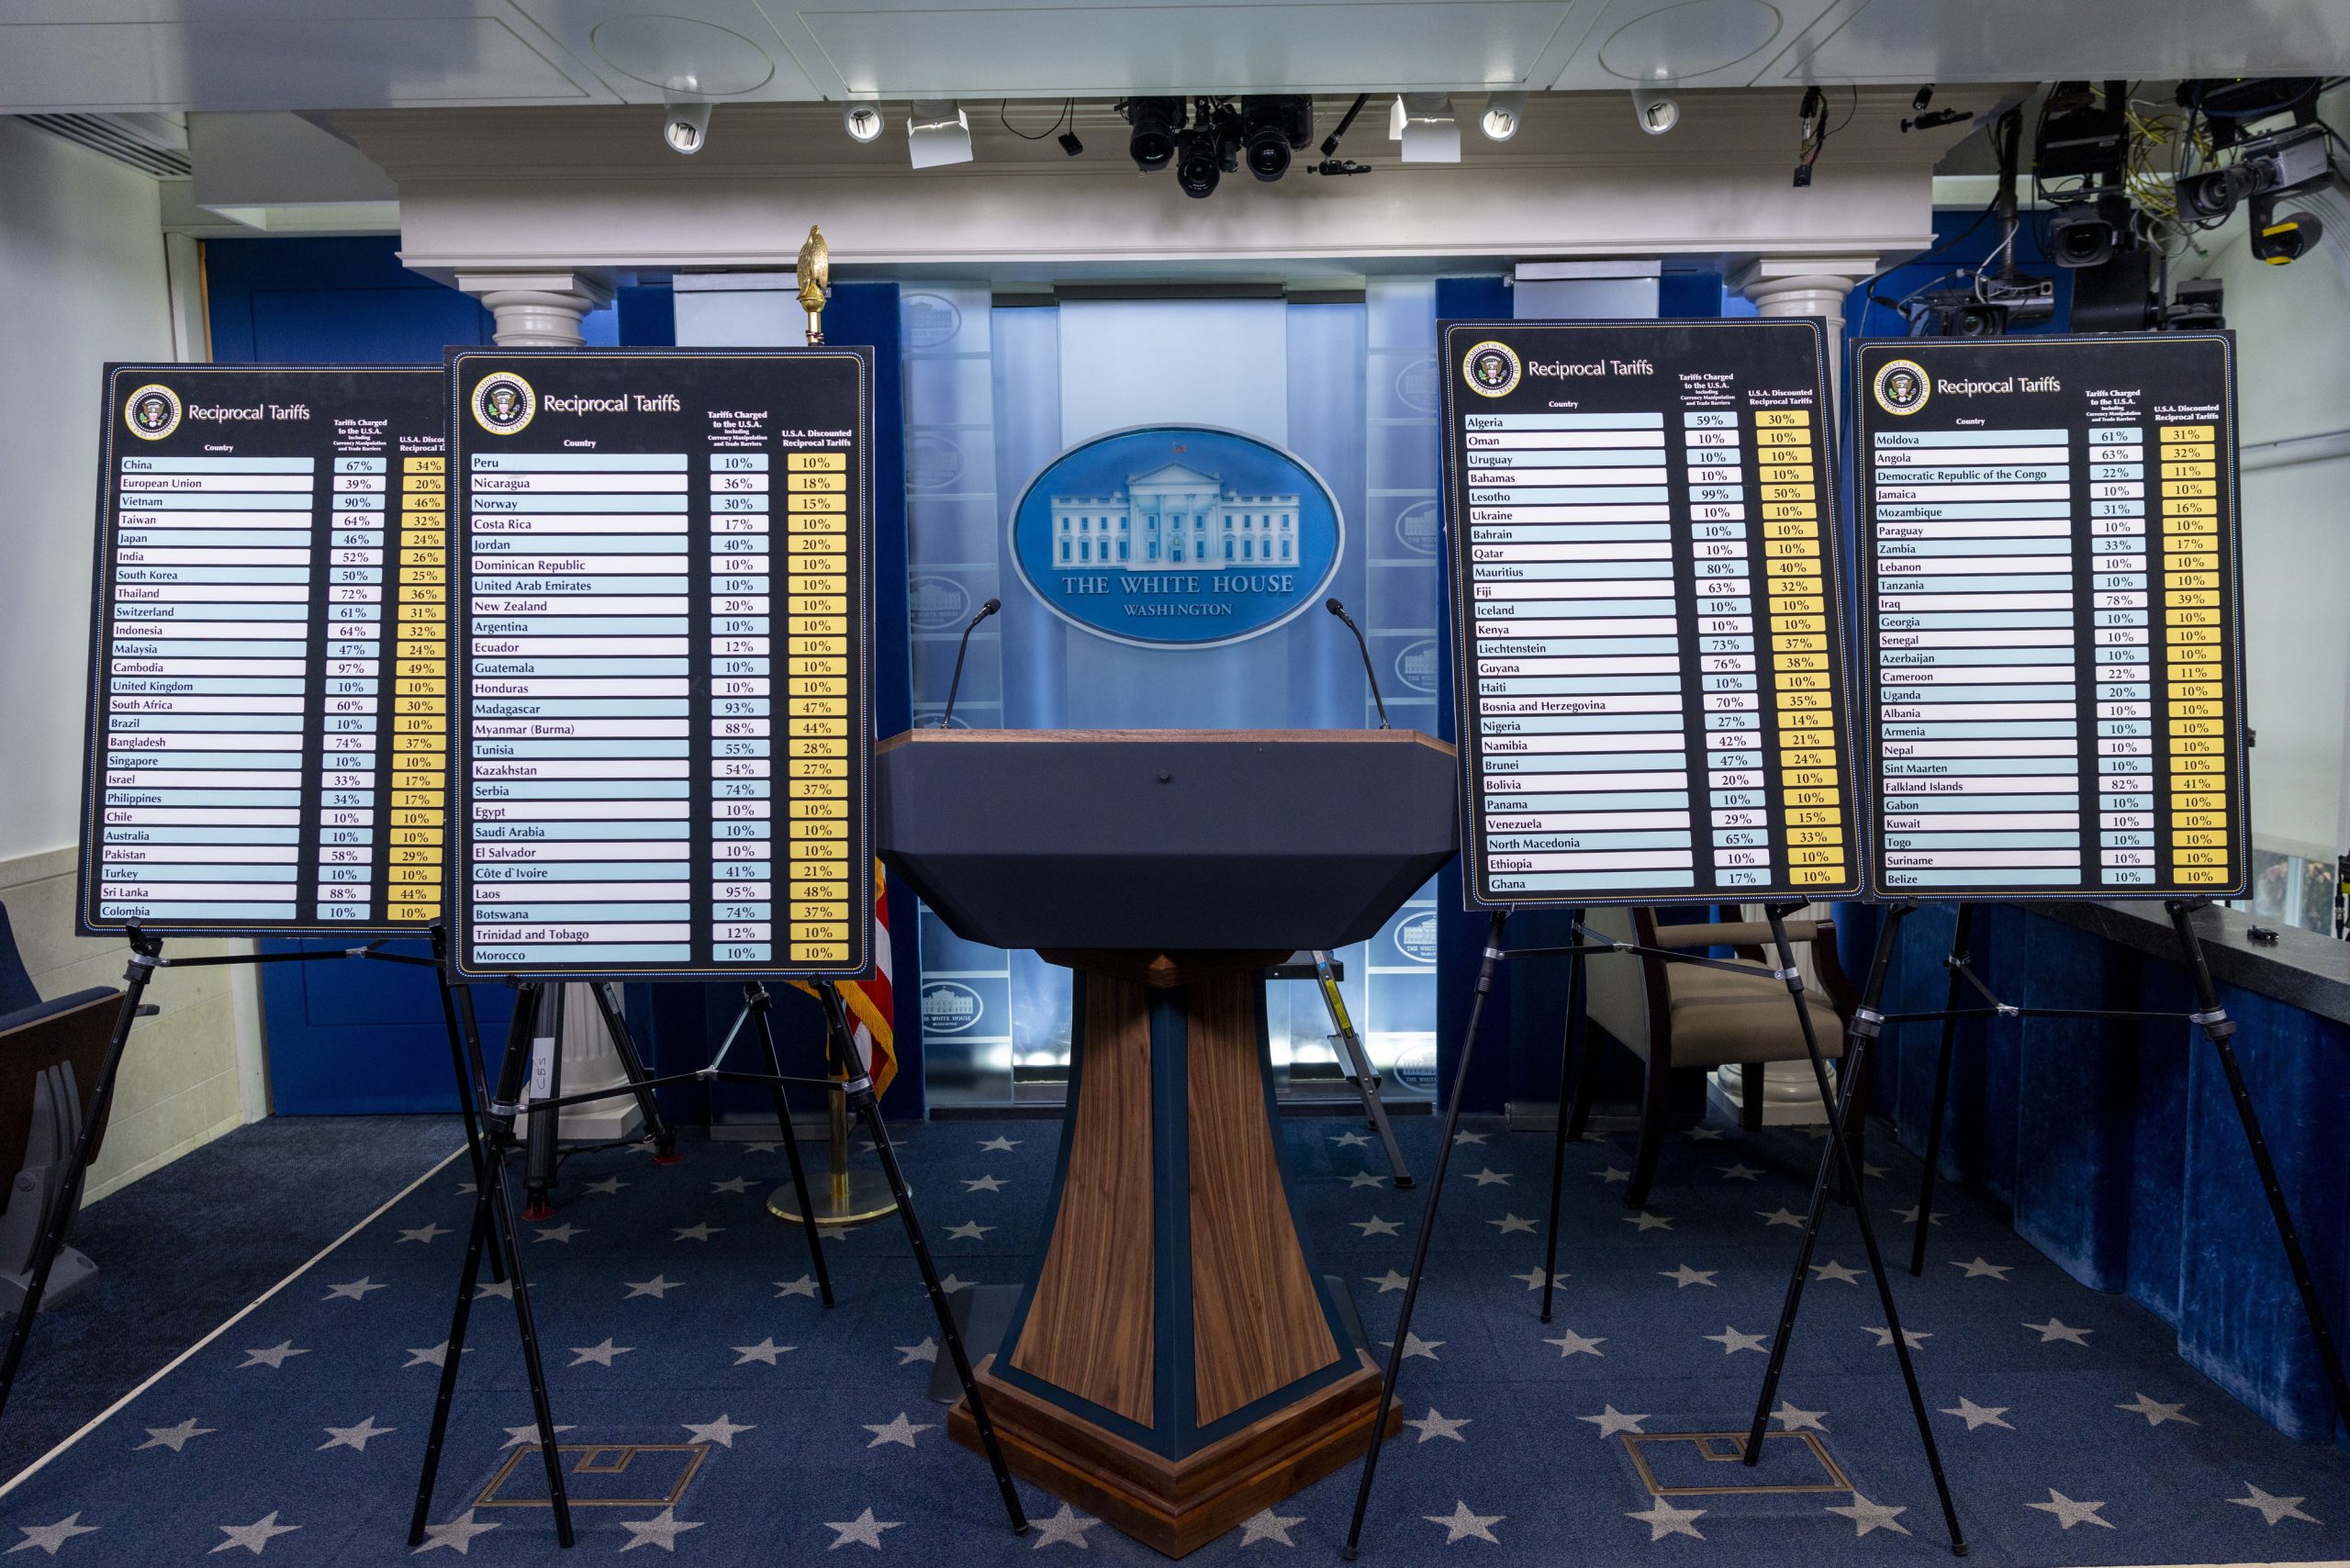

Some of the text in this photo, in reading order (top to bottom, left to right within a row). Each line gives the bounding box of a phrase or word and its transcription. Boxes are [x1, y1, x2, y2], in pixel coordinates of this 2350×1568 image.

[1465, 343, 1489, 367] PRESIDENT
[1528, 360, 1654, 379] Reciprocal Tariffs
[475, 375, 502, 401] PRESIDENT
[1938, 376, 2061, 396] Reciprocal Tariffs
[543, 394, 680, 416] Reciprocal Tariffs
[1549, 400, 1578, 409] Country
[1751, 398, 1788, 407] Reciprocal
[189, 404, 310, 424] Reciprocal Tariffs
[734, 411, 767, 420] Charged
[1696, 414, 1724, 426] 59%
[1768, 413, 1796, 425] 30%
[1467, 417, 1504, 430] Algeria
[1956, 418, 1986, 427] Country
[1876, 434, 1919, 445] Moldova
[2101, 431, 2129, 442] 61%
[2173, 429, 2200, 441] 31%
[205, 444, 233, 453] Country
[564, 439, 596, 448] Country
[783, 440, 824, 448] Reciprocal
[123, 459, 152, 470] China
[346, 460, 373, 471] 67%
[416, 460, 442, 471] 34%
[2176, 465, 2201, 476] 11%
[1877, 469, 2047, 483] Democratic Republic of the Congo
[2102, 467, 2130, 478] 22%
[123, 478, 202, 490] European Union
[345, 478, 372, 489] 39%
[415, 478, 442, 489] 20%
[1471, 491, 1511, 502] Lesotho
[1701, 488, 1729, 499] 99%
[1774, 487, 1801, 498] 50%
[474, 498, 519, 512] Norway
[724, 498, 754, 510] 30%
[802, 498, 831, 510] 15%
[2103, 504, 2131, 515] 31%
[2176, 502, 2202, 513] 16%
[1878, 507, 1942, 520] Mozambique
[475, 579, 592, 591] United Arab Emirates
[725, 579, 754, 591] 10%
[803, 578, 832, 591] 10%
[1061, 575, 1294, 594] THE WHITE HOUSE
[1708, 582, 1736, 593] 63%
[1781, 580, 1808, 592] 32%
[1475, 586, 1492, 599] Fiji
[2177, 593, 2205, 604] 39%
[1881, 599, 1901, 610] Iraq
[2106, 595, 2133, 606] 78%
[116, 607, 174, 617] Switzerland
[340, 607, 367, 618] 61%
[410, 607, 437, 618] 31%
[1124, 603, 1232, 617] WASHINGTON
[1479, 643, 1547, 654] Liechtenstein
[1712, 639, 1740, 651] 73%
[1785, 637, 1813, 649] 37%
[1882, 672, 1933, 682] Cameroon
[2109, 667, 2135, 679] 22%
[2181, 667, 2208, 678] 11%
[113, 680, 194, 694] United Kingdom
[339, 681, 364, 692] 10%
[408, 681, 434, 693] 10%
[802, 701, 832, 713] 47%
[1482, 700, 1606, 713] Bosnia and Herzegovina
[1716, 696, 1744, 708] 70%
[1789, 695, 1818, 707] 35%
[475, 703, 541, 717] Madagascar
[724, 701, 755, 714] 93%
[475, 724, 575, 737] Myanmar (Burma)
[725, 722, 755, 734] 88%
[802, 722, 832, 734] 44%
[110, 736, 166, 749] Bangladesh
[335, 737, 362, 749] 74%
[406, 737, 432, 749] 37%
[1886, 781, 1964, 792] Falkland Islands
[2111, 778, 2139, 790] 82%
[2183, 778, 2211, 790] 41%
[1489, 837, 1581, 849] North Macedonia
[1725, 833, 1753, 845] 65%
[1799, 831, 1828, 843] 33%
[475, 868, 502, 879] Côte
[725, 866, 755, 878] 41%
[803, 865, 833, 877] 21%
[2115, 871, 2141, 882] 10%
[2188, 871, 2213, 882] 10%
[1887, 874, 1919, 884] Belize
[103, 887, 149, 898] Sri Lanka
[330, 888, 357, 899] 88%
[400, 889, 427, 900] 44%
[476, 889, 501, 900] Laos
[725, 886, 755, 898] 95%
[803, 885, 833, 898] 48%
